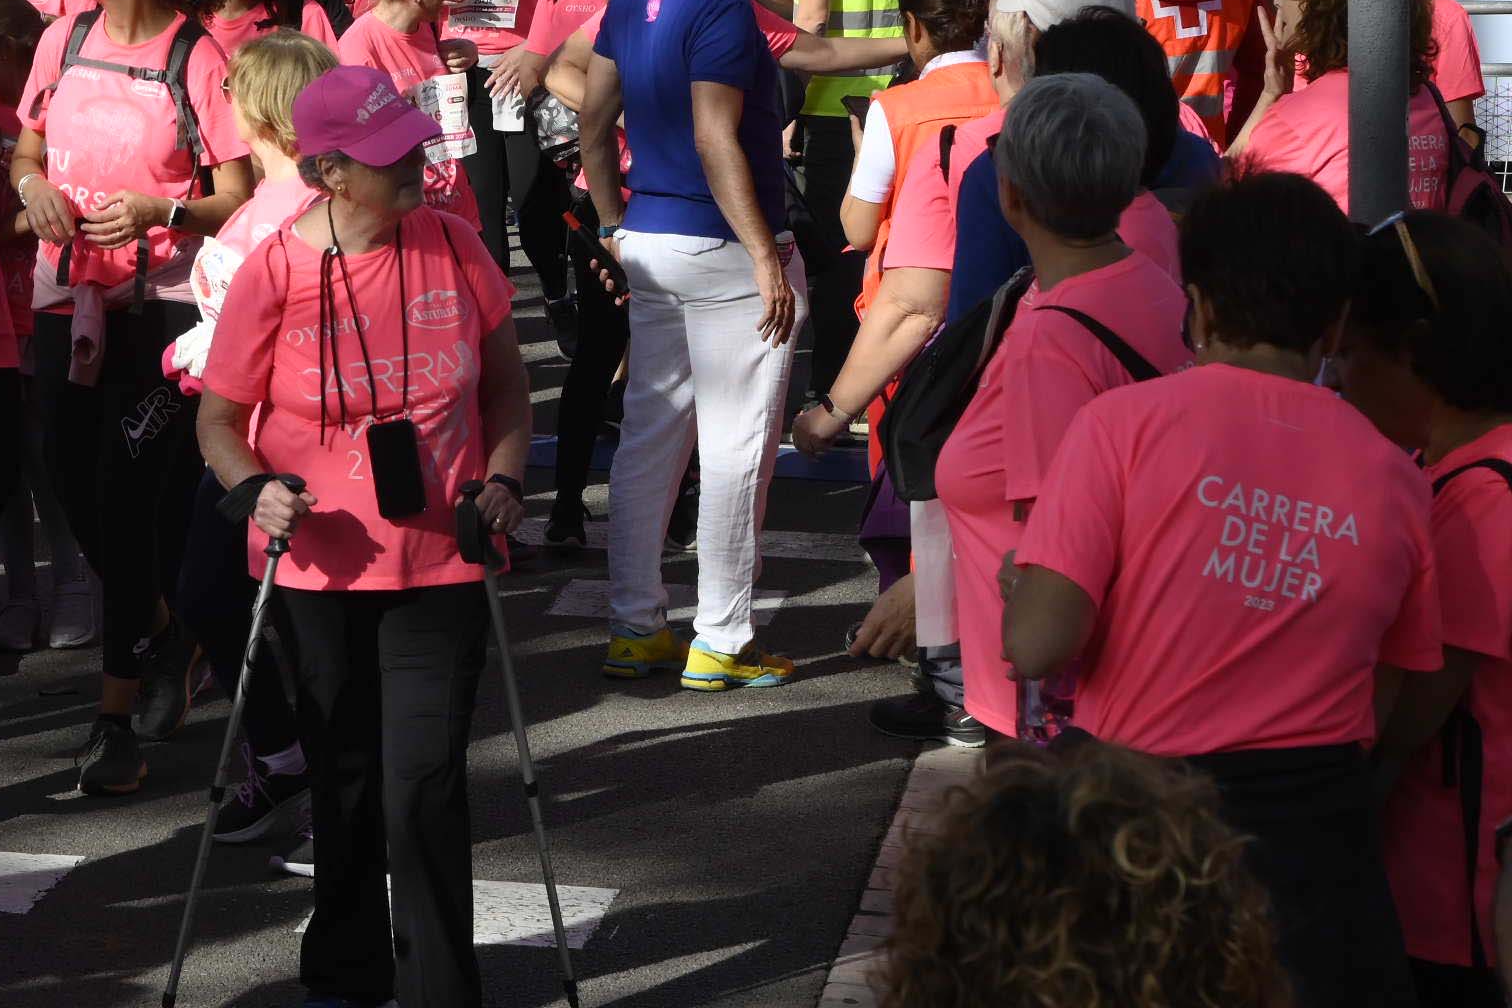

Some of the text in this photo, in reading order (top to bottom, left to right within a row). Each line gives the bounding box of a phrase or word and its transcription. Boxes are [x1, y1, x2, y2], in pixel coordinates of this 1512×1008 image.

[1409, 136, 1445, 150] RERA
[286, 314, 371, 347] OYSHO
[411, 304, 460, 323] ASTURIA
[298, 350, 458, 402] CARRERA
[121, 386, 181, 458] AIR
[1197, 475, 1360, 546] CARRERA
[1221, 515, 1320, 570] DE LA
[1202, 547, 1322, 601] MUJER
